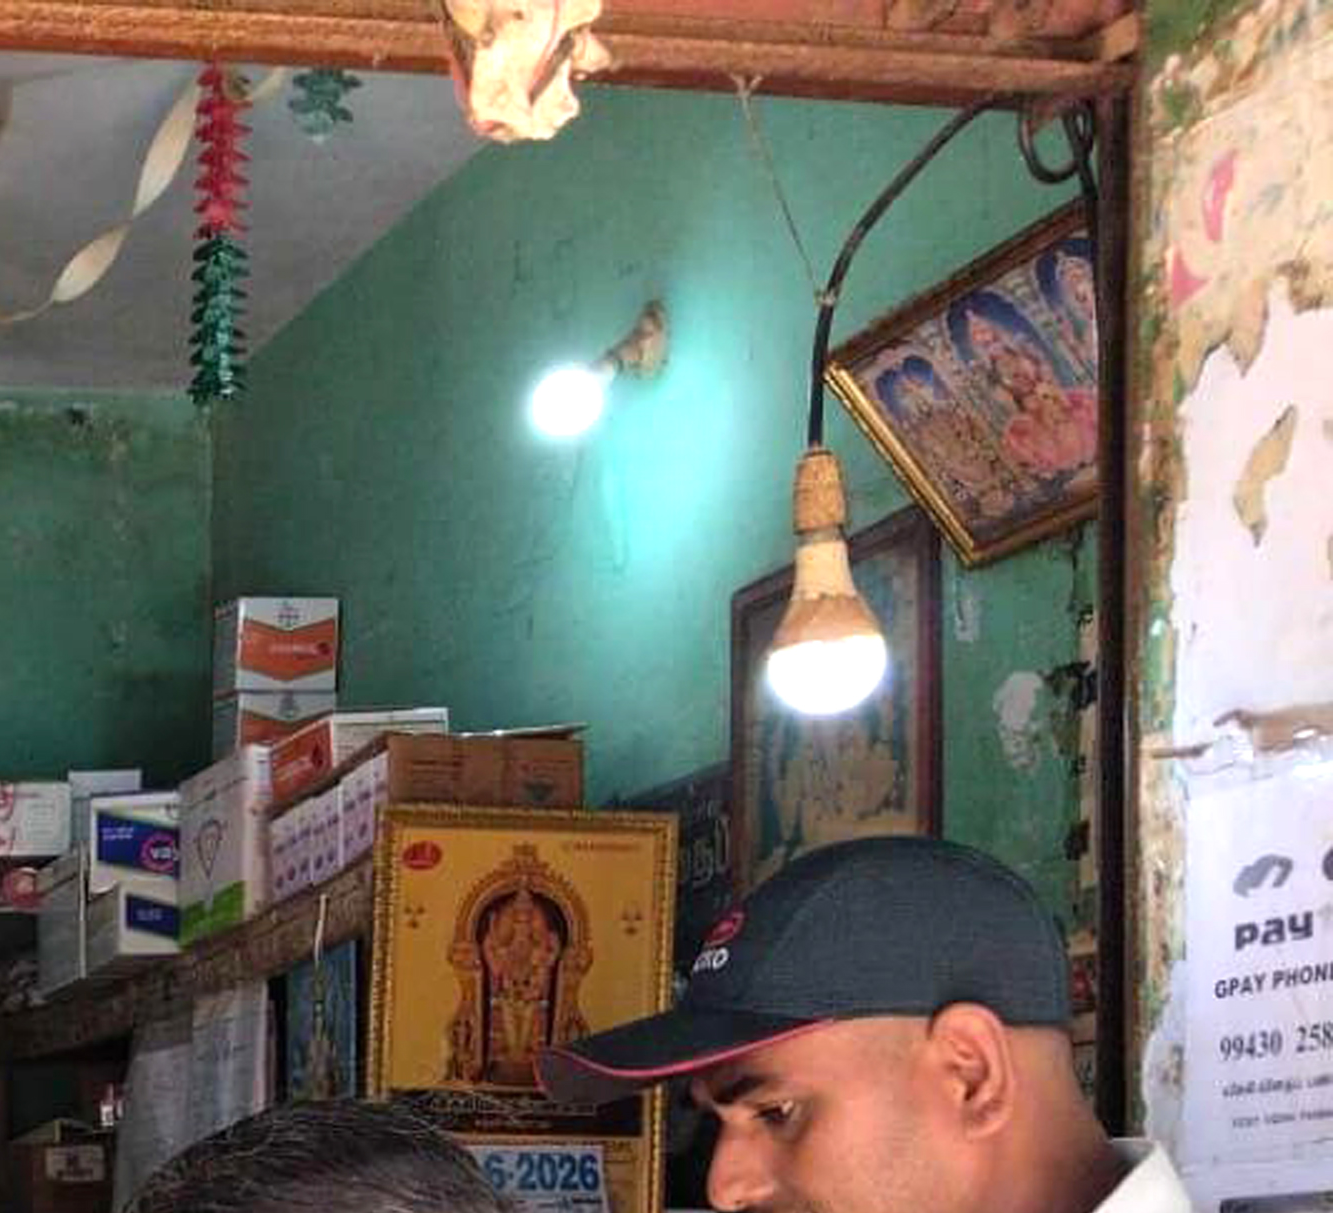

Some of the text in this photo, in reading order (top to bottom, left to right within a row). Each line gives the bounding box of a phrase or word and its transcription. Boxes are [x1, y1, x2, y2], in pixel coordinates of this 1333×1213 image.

[1234, 910, 1314, 951] pay
[1214, 973, 1266, 999] GPAY
[1219, 1028, 1283, 1061] 99430
